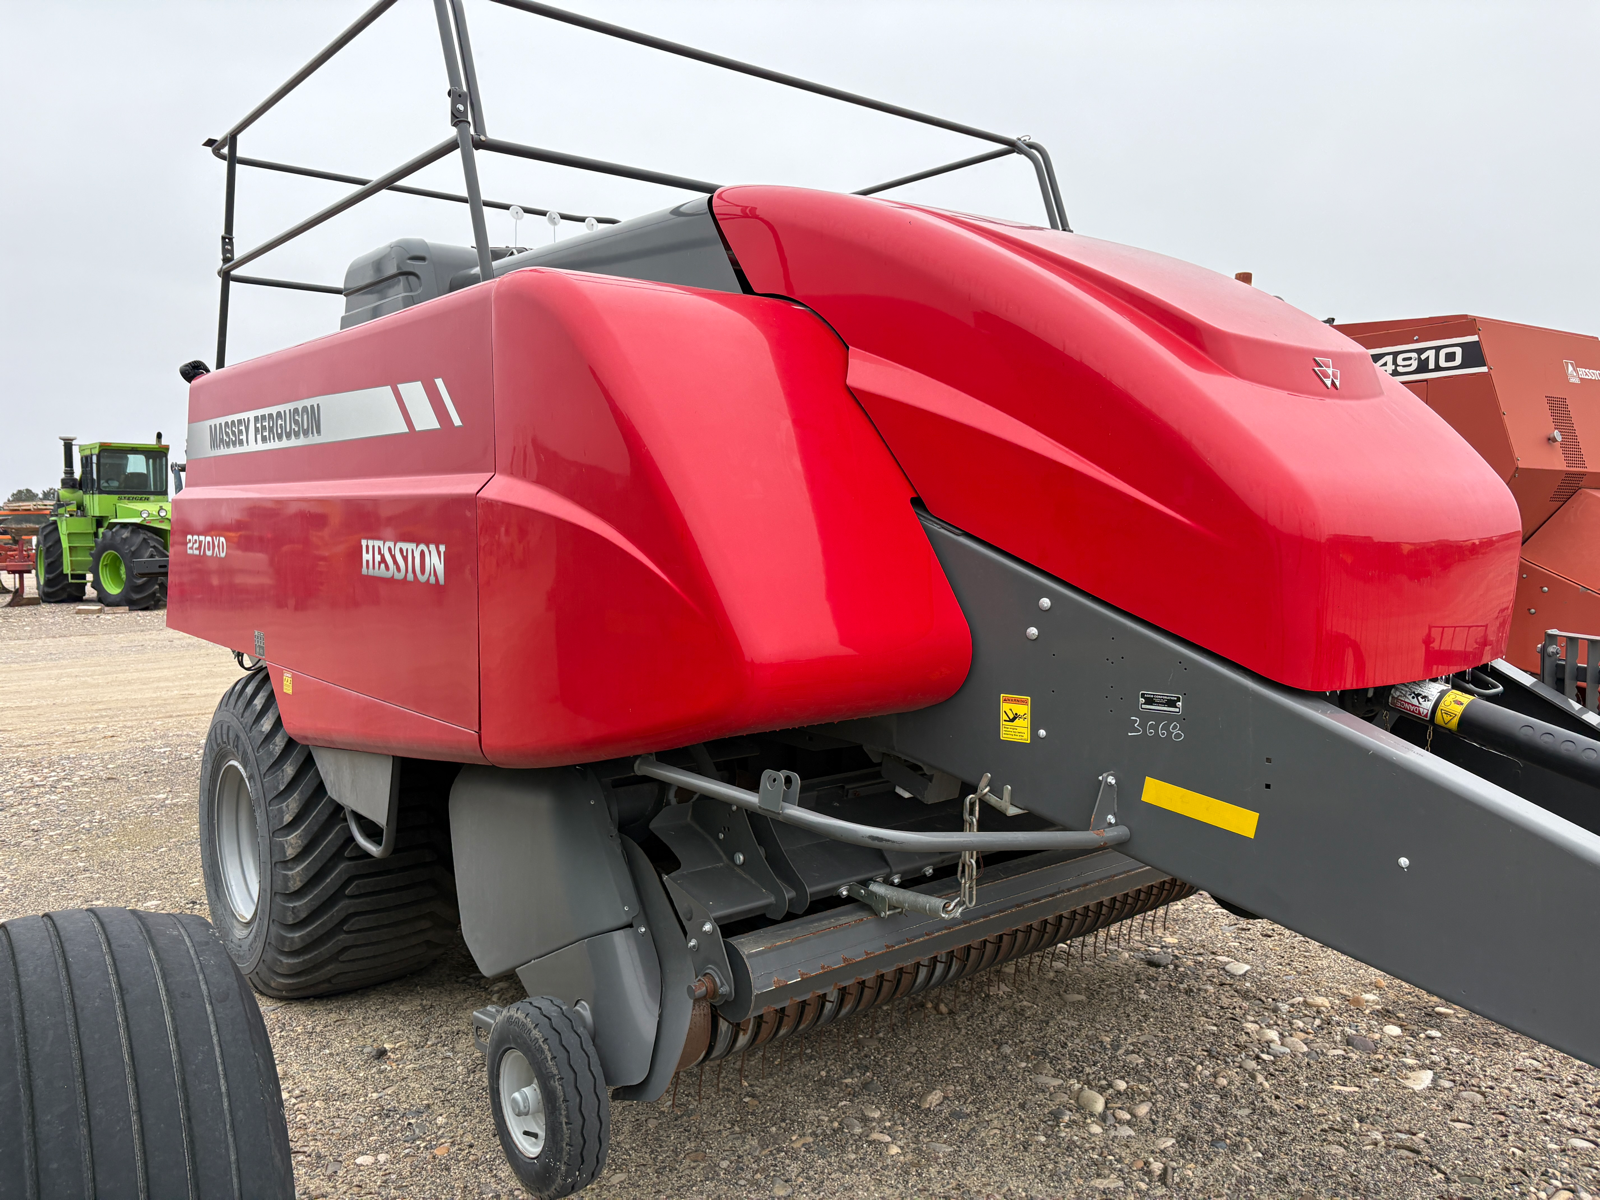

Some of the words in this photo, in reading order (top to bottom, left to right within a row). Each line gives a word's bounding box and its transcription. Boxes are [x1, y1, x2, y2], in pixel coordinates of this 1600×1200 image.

[1374, 346, 1462, 374] 4910
[209, 415, 251, 451] MASSEY
[254, 403, 322, 443] FERGUSON
[361, 538, 446, 586] HESSTON
[1128, 716, 1185, 742] 3668
